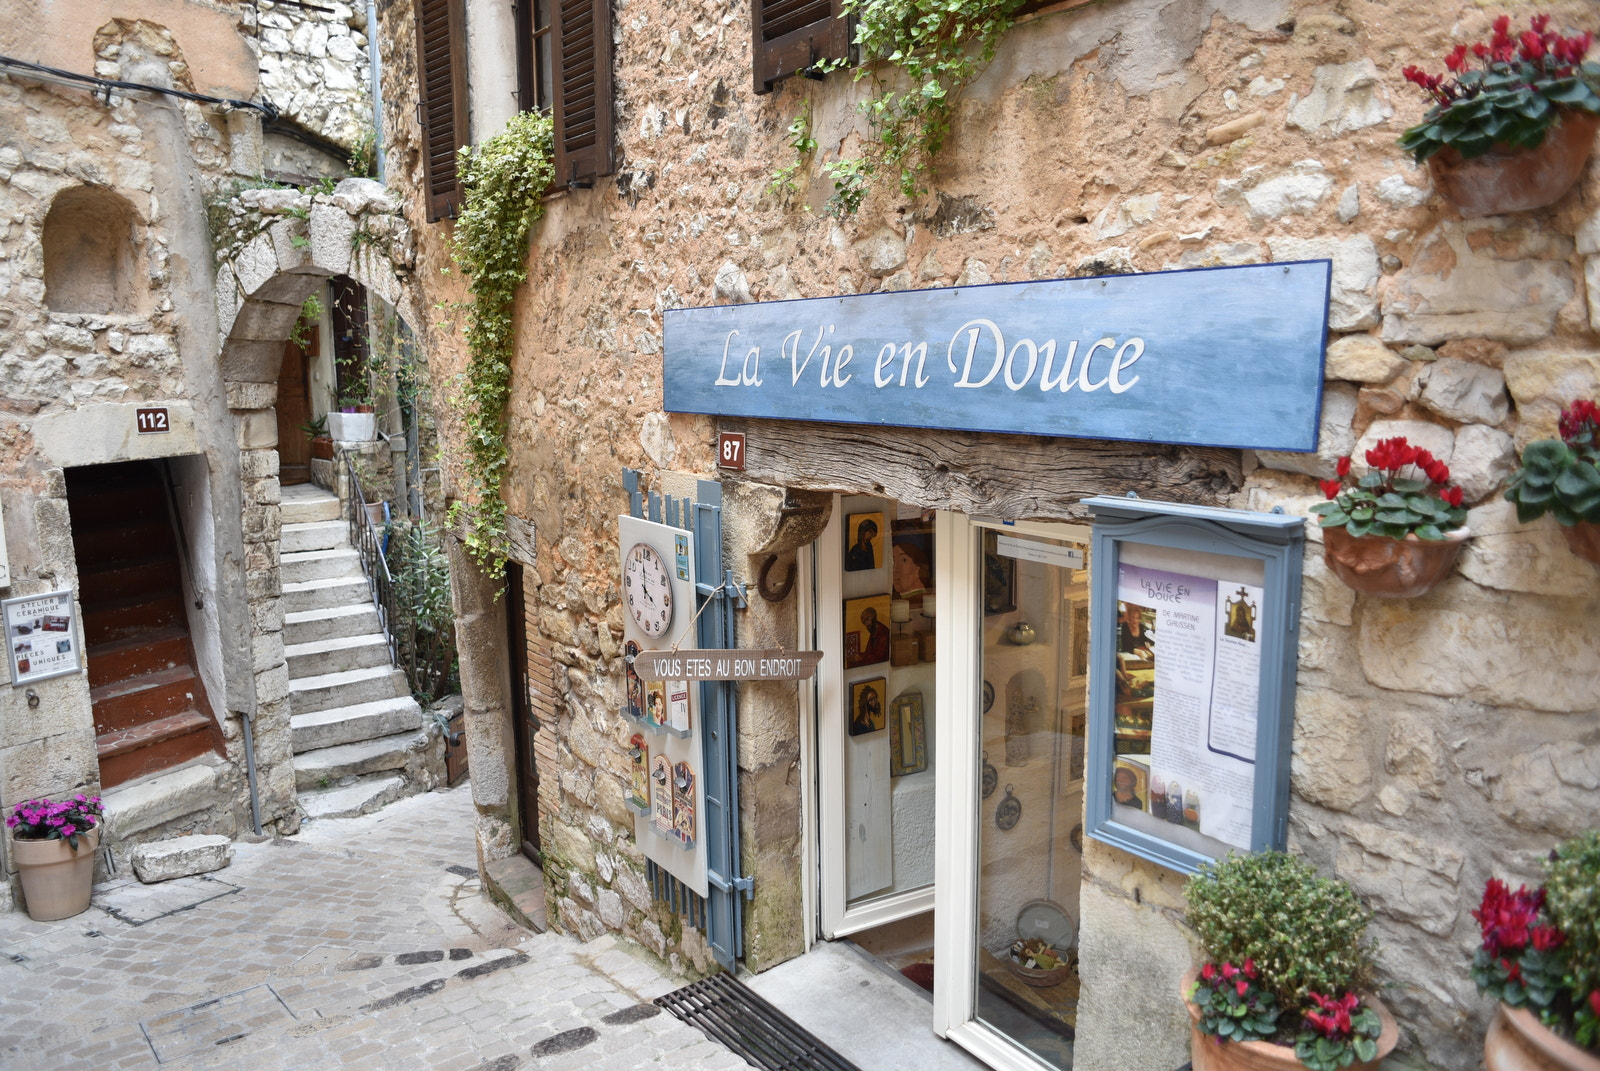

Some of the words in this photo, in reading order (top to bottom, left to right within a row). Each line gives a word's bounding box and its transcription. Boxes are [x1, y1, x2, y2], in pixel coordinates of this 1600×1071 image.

[714, 329, 763, 387] La
[781, 323, 854, 388] Vie
[874, 341, 929, 388] en
[947, 318, 1145, 394] Douce
[139, 412, 167, 429] 112
[723, 440, 740, 461] 87
[20, 599, 54, 609] ATELIER
[32, 654, 66, 666] UNIQUES
[653, 659, 681, 677] VOUS
[686, 659, 712, 677] ETES
[716, 659, 730, 677] AU
[734, 659, 755, 676] BON
[760, 659, 802, 676] ENDROIT
